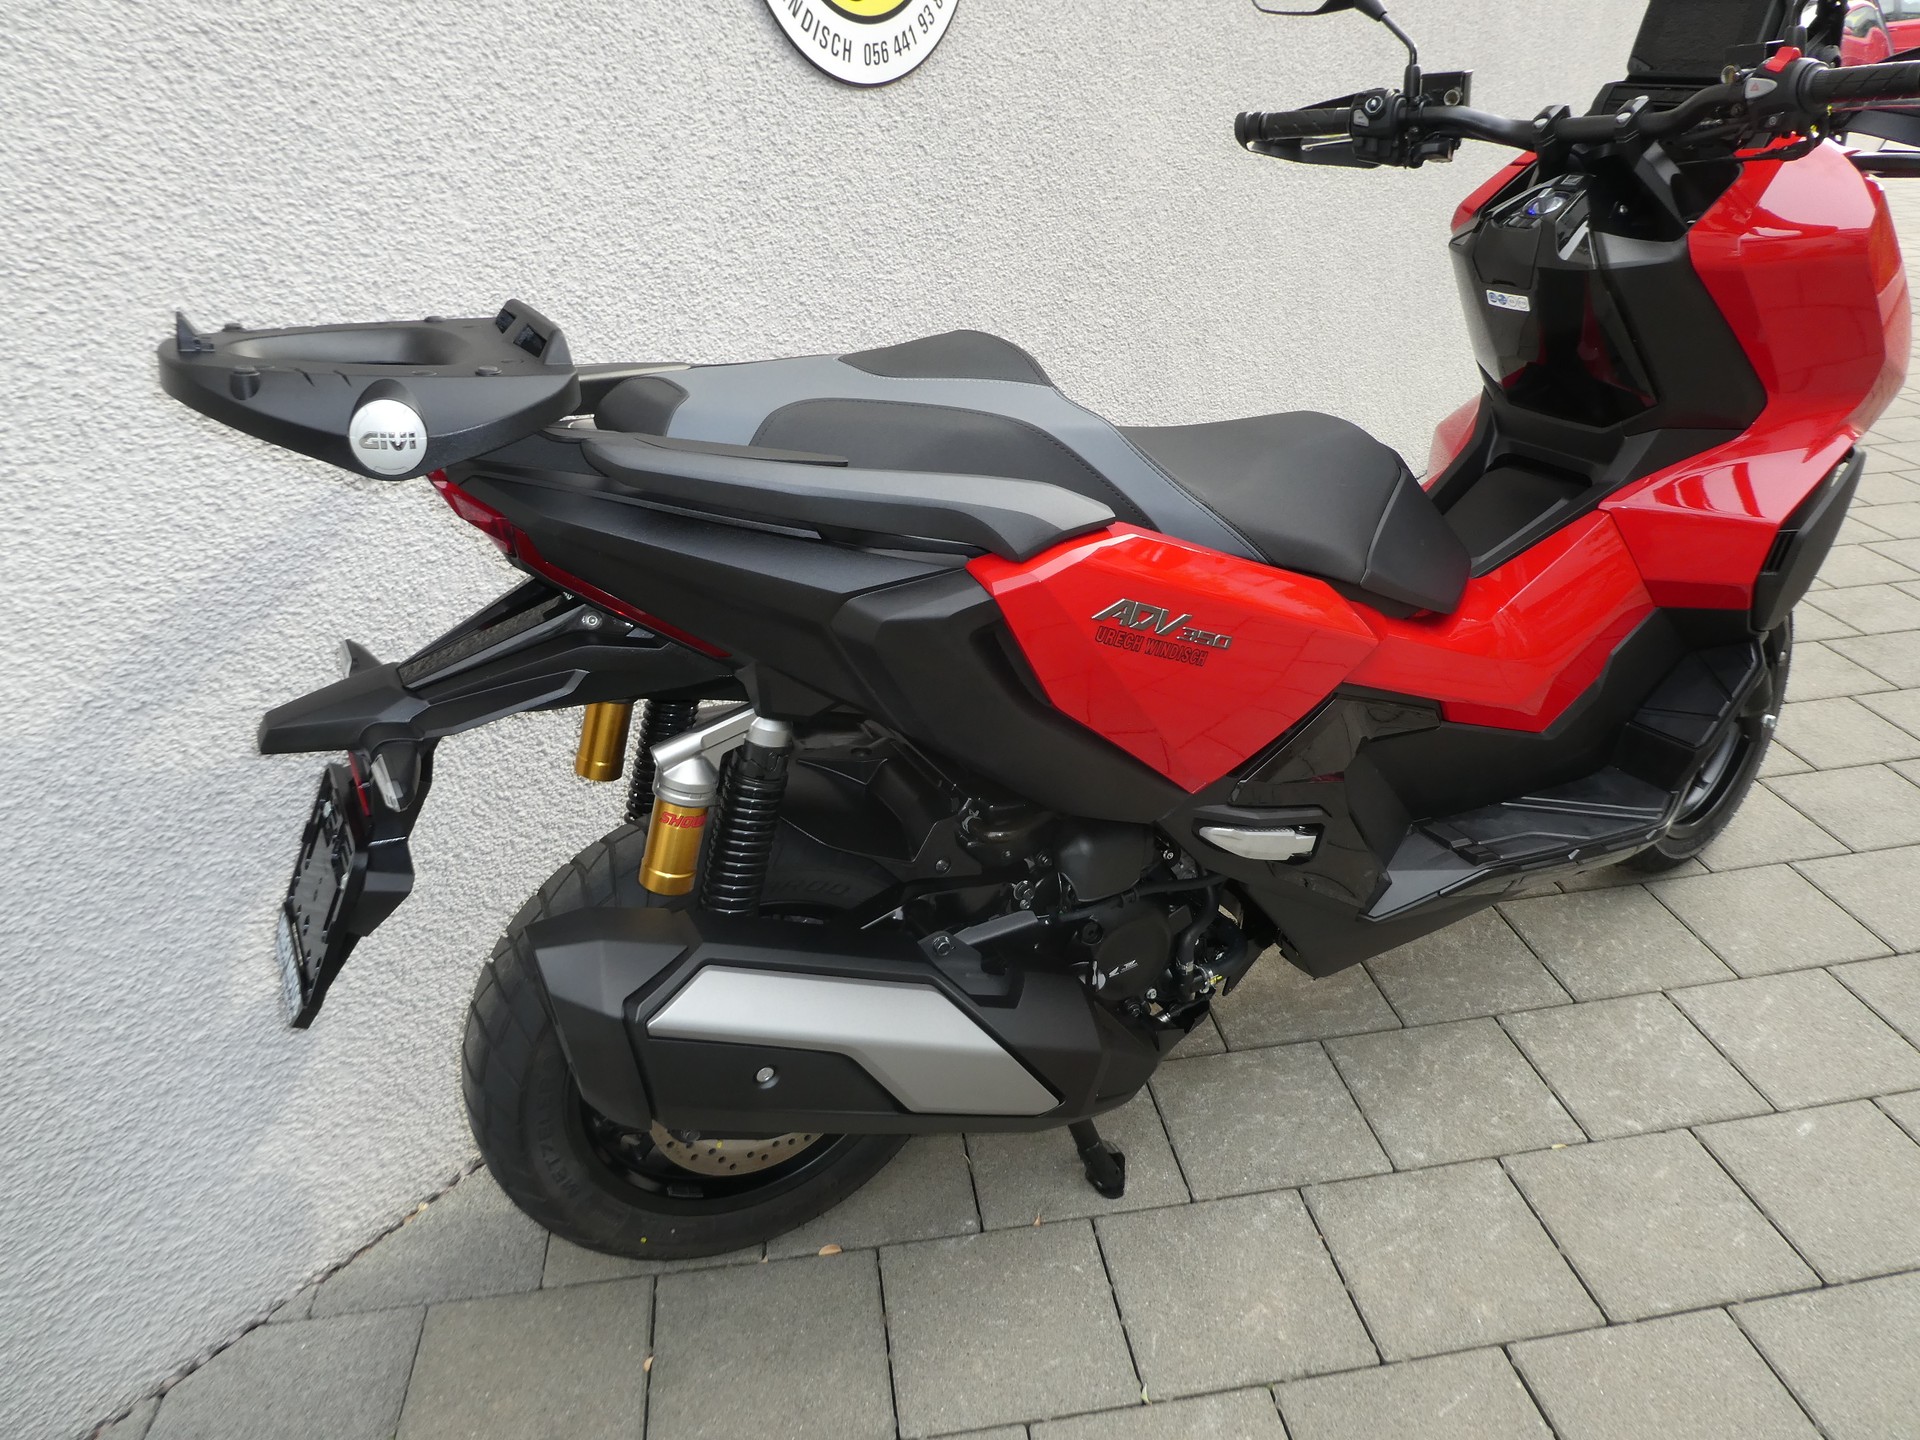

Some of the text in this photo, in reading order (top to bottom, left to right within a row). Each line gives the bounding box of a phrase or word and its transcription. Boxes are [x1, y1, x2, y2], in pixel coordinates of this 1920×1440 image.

[783, 0, 935, 66] NDISCH 056 441 93
[358, 431, 417, 451] GIVI
[1091, 598, 1233, 649] ADV 350
[1095, 625, 1209, 666] URECH WINDISCH
